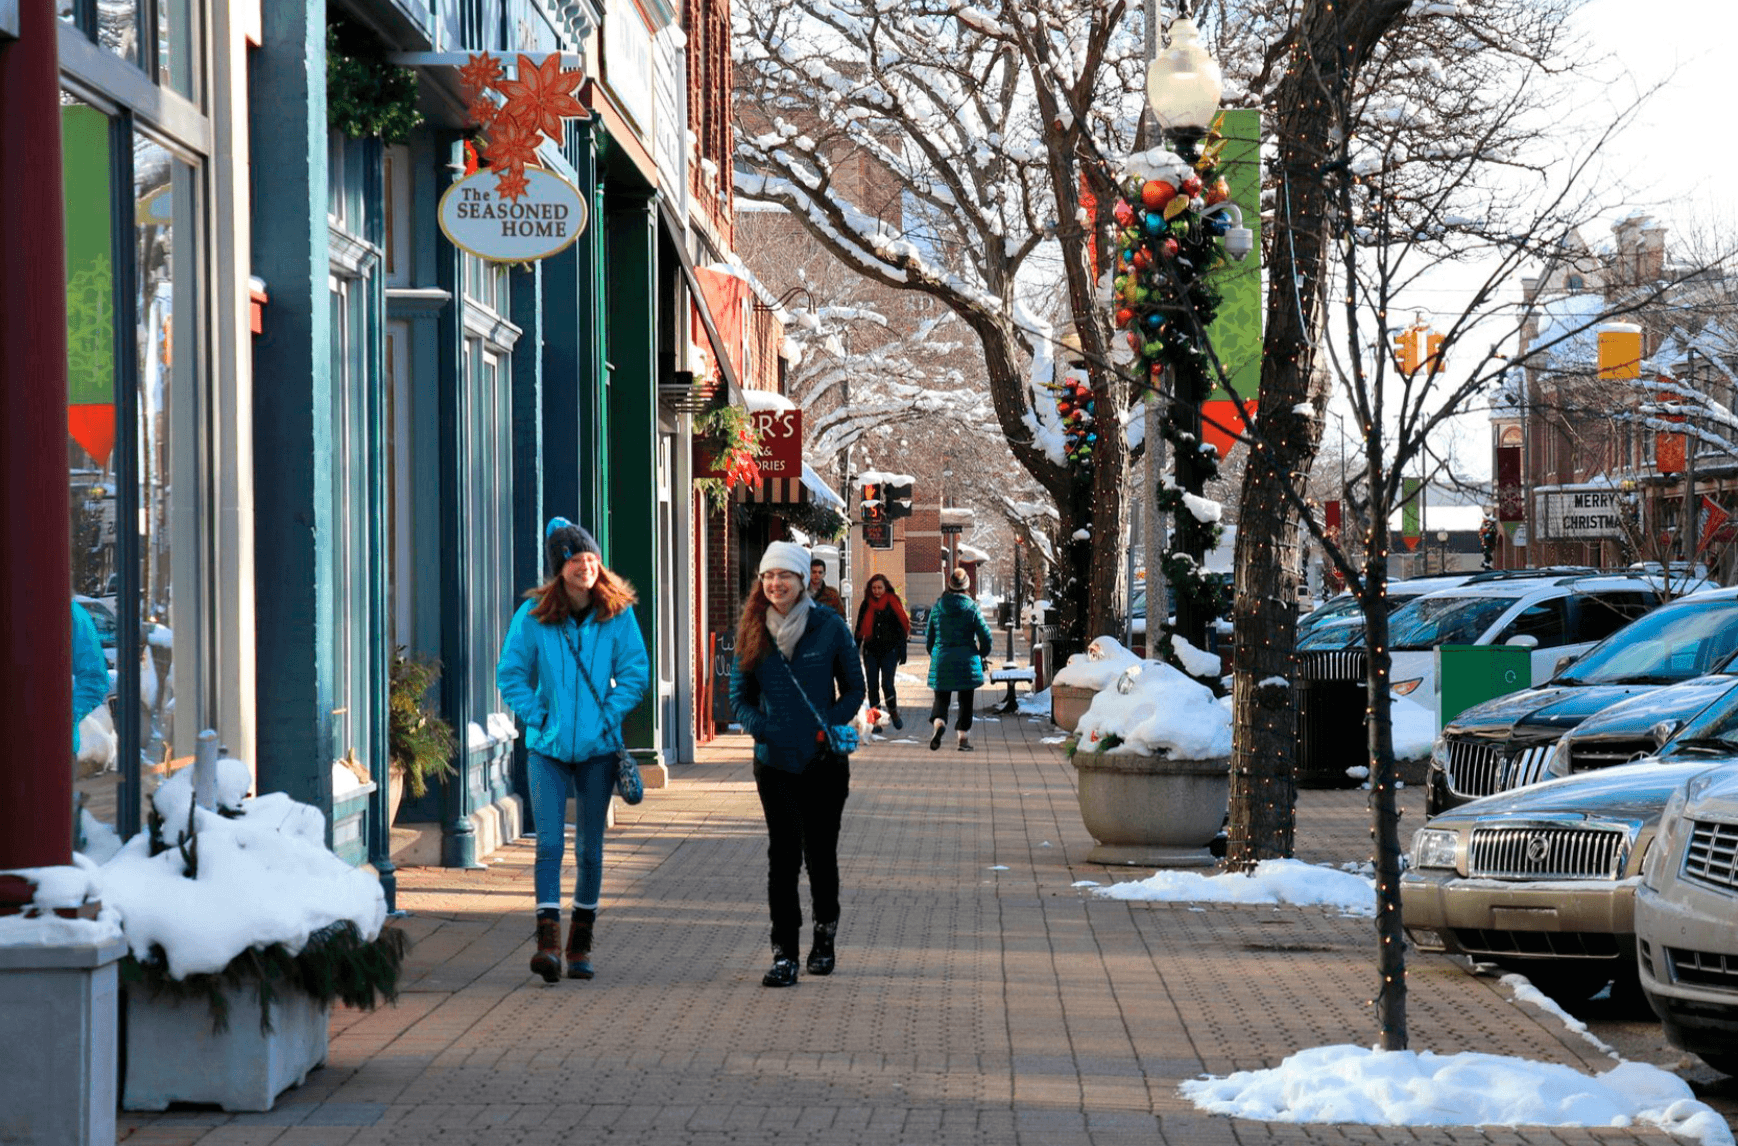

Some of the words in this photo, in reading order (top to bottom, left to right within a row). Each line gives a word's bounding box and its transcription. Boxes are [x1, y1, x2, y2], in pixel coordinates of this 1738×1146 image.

[461, 188, 490, 201] The
[457, 202, 569, 220] SEASONED
[501, 220, 567, 237] HOME
[750, 414, 795, 438] R'S
[763, 446, 773, 457] &
[1574, 494, 1616, 508] MERRY
[1562, 515, 1622, 530] CHRISTMA
